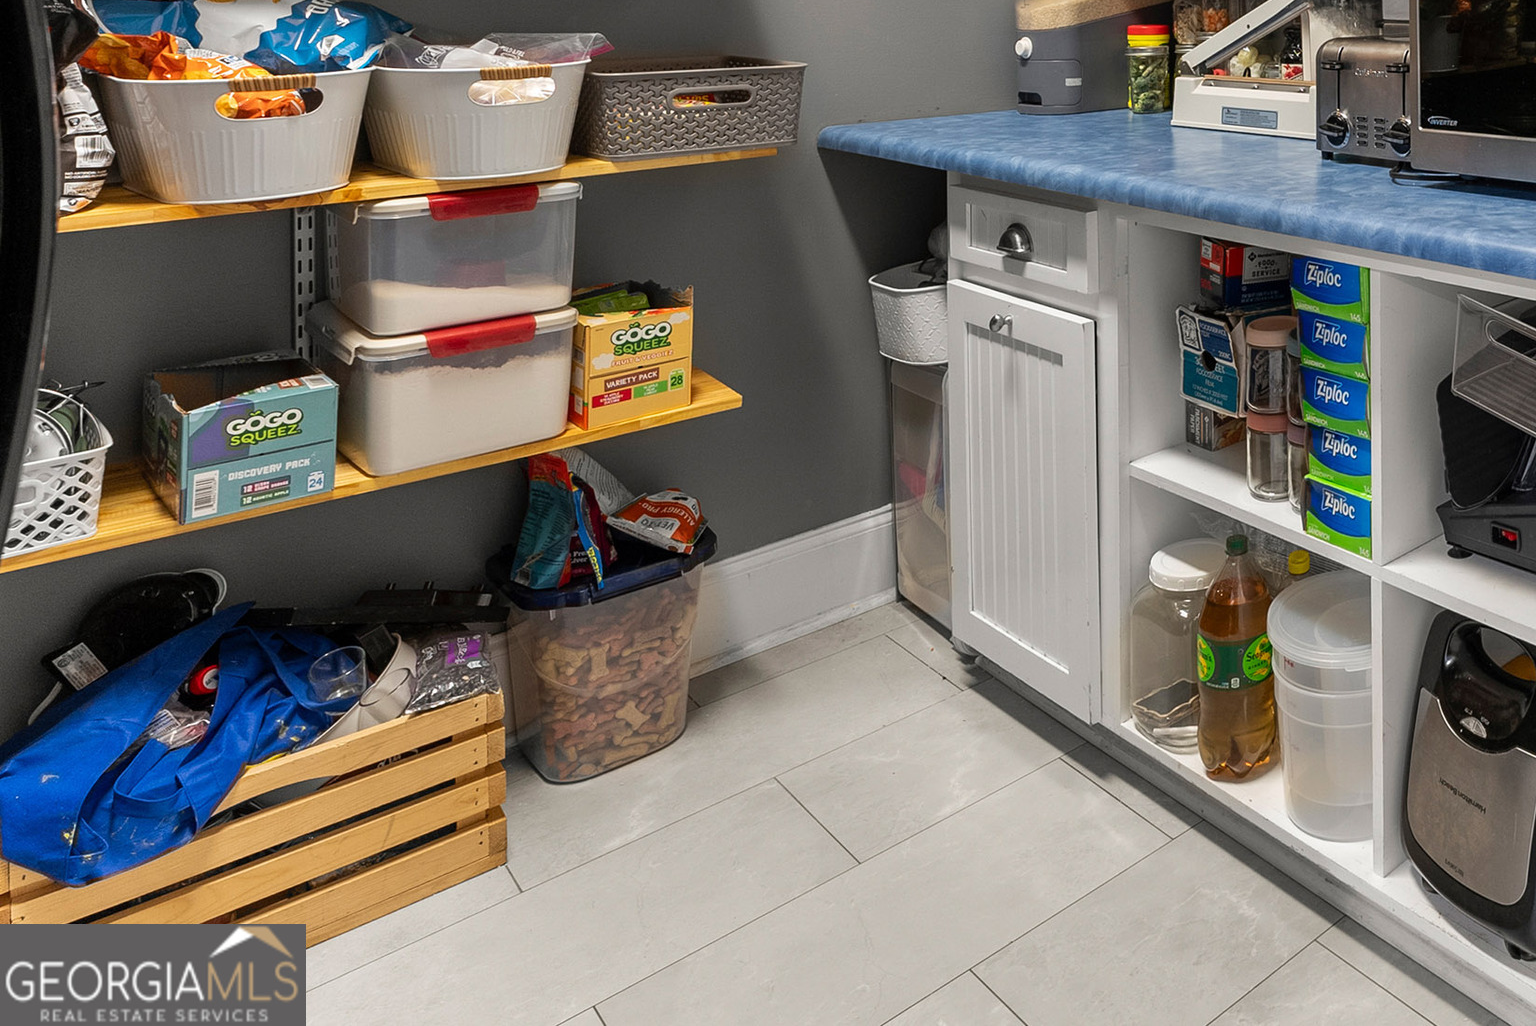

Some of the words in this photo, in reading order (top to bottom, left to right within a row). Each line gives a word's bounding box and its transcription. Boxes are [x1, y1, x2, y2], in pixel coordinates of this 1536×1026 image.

[1430, 118, 1458, 127] INVERTER
[1307, 263, 1342, 288] Ziploc
[611, 321, 672, 346] GOGO
[1315, 321, 1348, 348] Ziploc
[614, 336, 670, 356] SQUEEZ
[605, 375, 638, 388] VARIETY
[638, 370, 659, 381] PACK
[670, 375, 684, 386] 28
[1316, 379, 1350, 406] Ziploc
[226, 407, 303, 436] GOGO
[230, 423, 302, 447] SQUEEZ
[1324, 431, 1358, 460] Ziploc
[228, 461, 282, 481] DISCOVERY
[285, 457, 312, 472] PACK
[308, 476, 324, 488] 24
[659, 504, 696, 528] ALLERGY
[1323, 490, 1356, 520] Ziploc
[1438, 777, 1459, 797] Beach
[1457, 790, 1487, 815] Hamilton
